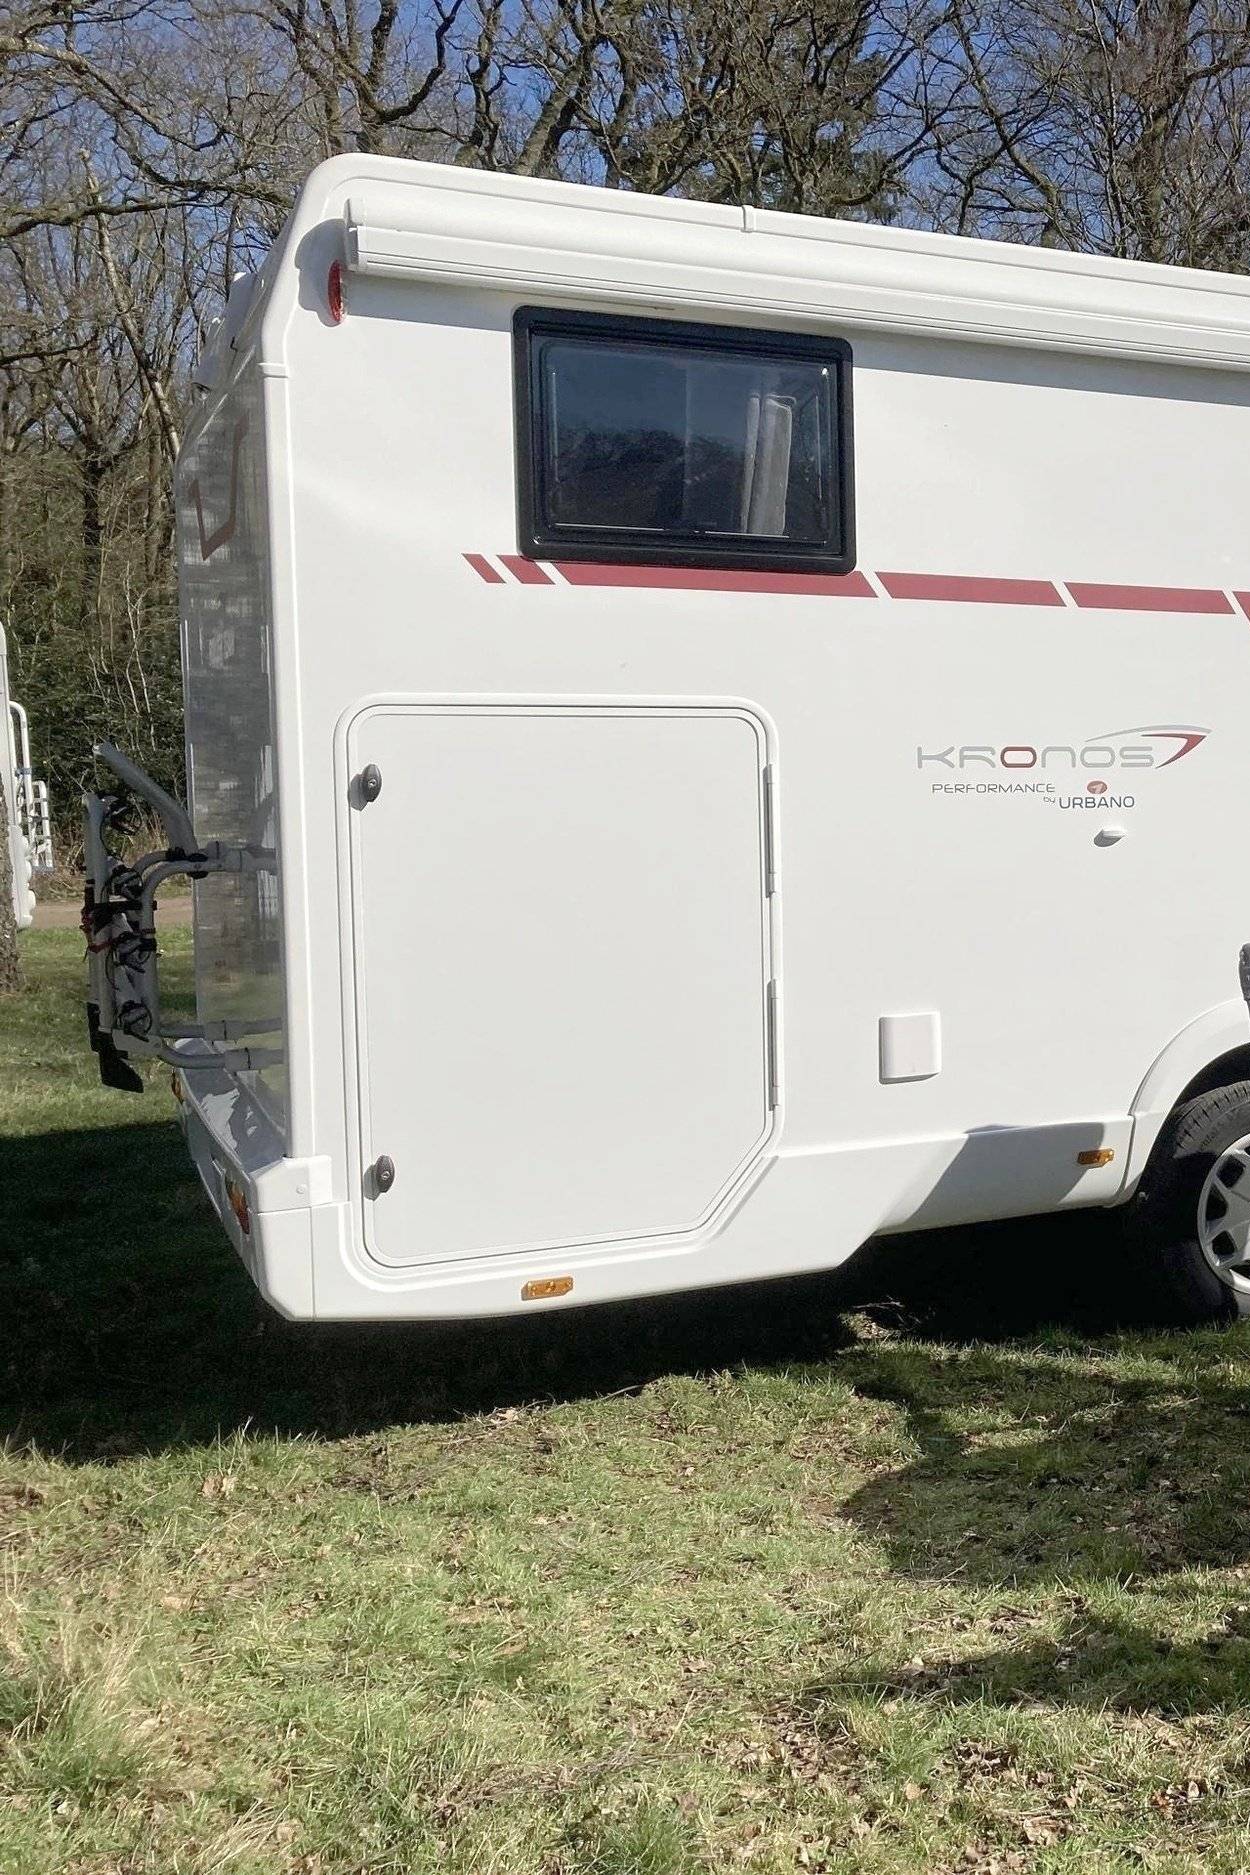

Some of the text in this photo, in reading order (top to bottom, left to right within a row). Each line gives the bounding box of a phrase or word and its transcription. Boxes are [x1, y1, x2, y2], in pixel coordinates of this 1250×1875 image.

[917, 746, 1154, 769] KRONOS
[932, 783, 1056, 794] PERFORMANCE
[1043, 796, 1135, 809] by URBANO
